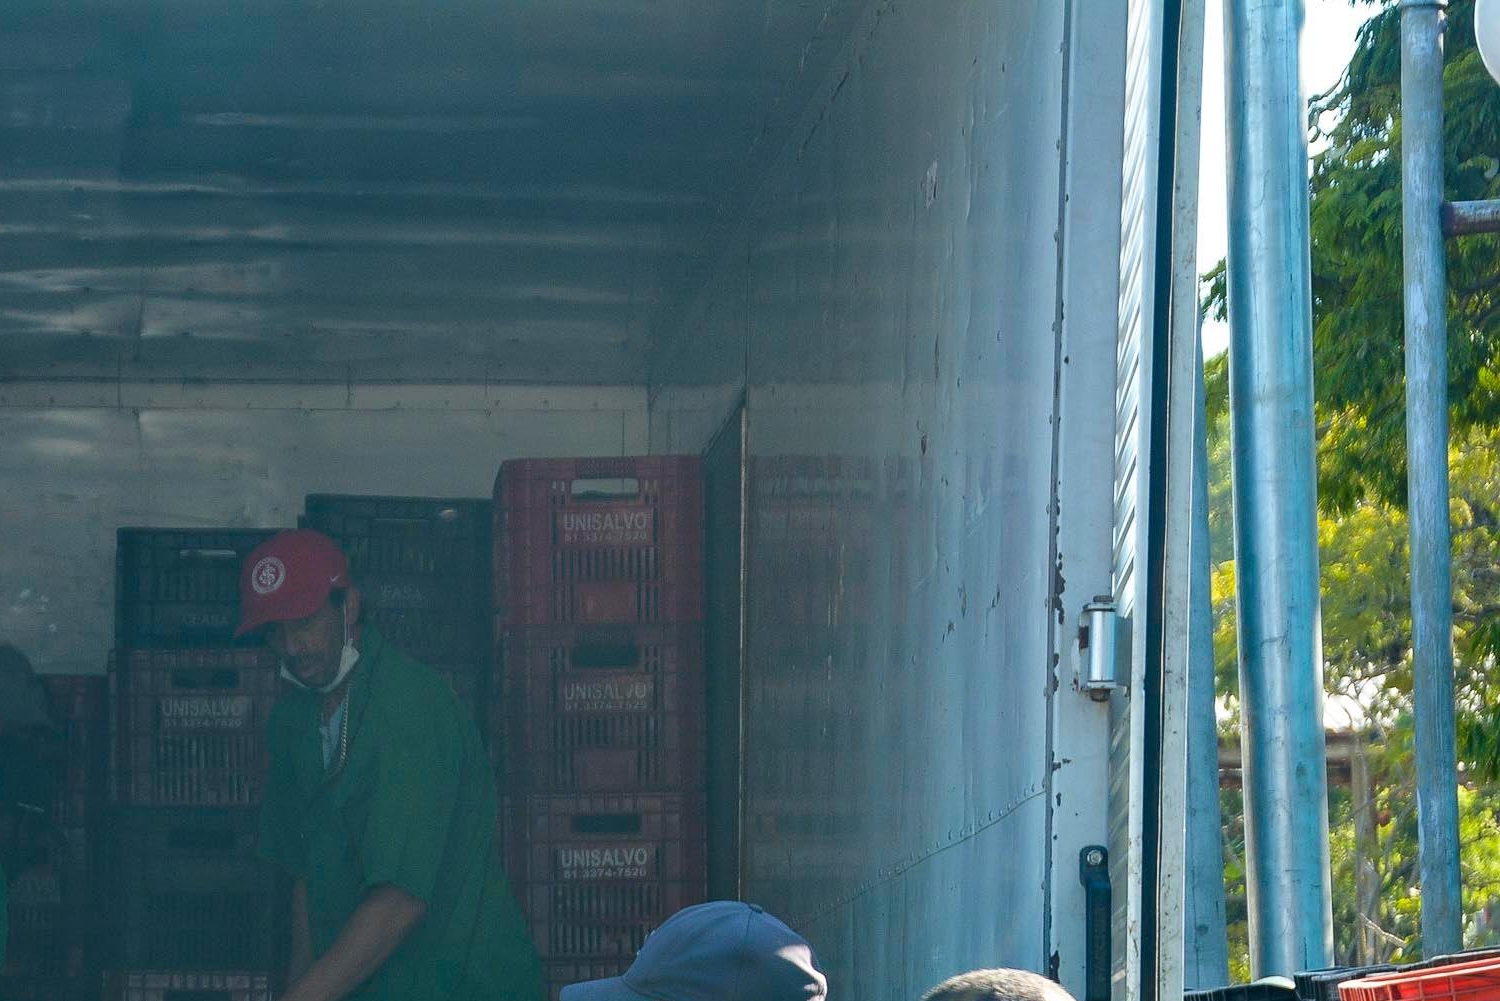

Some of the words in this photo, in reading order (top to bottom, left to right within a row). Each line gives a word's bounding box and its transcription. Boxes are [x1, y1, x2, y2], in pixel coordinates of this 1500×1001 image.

[563, 511, 648, 531] UNISALVO
[564, 682, 648, 700] UNISALVO
[161, 698, 244, 717] UNISALVO
[561, 848, 648, 866] UNISALVO
